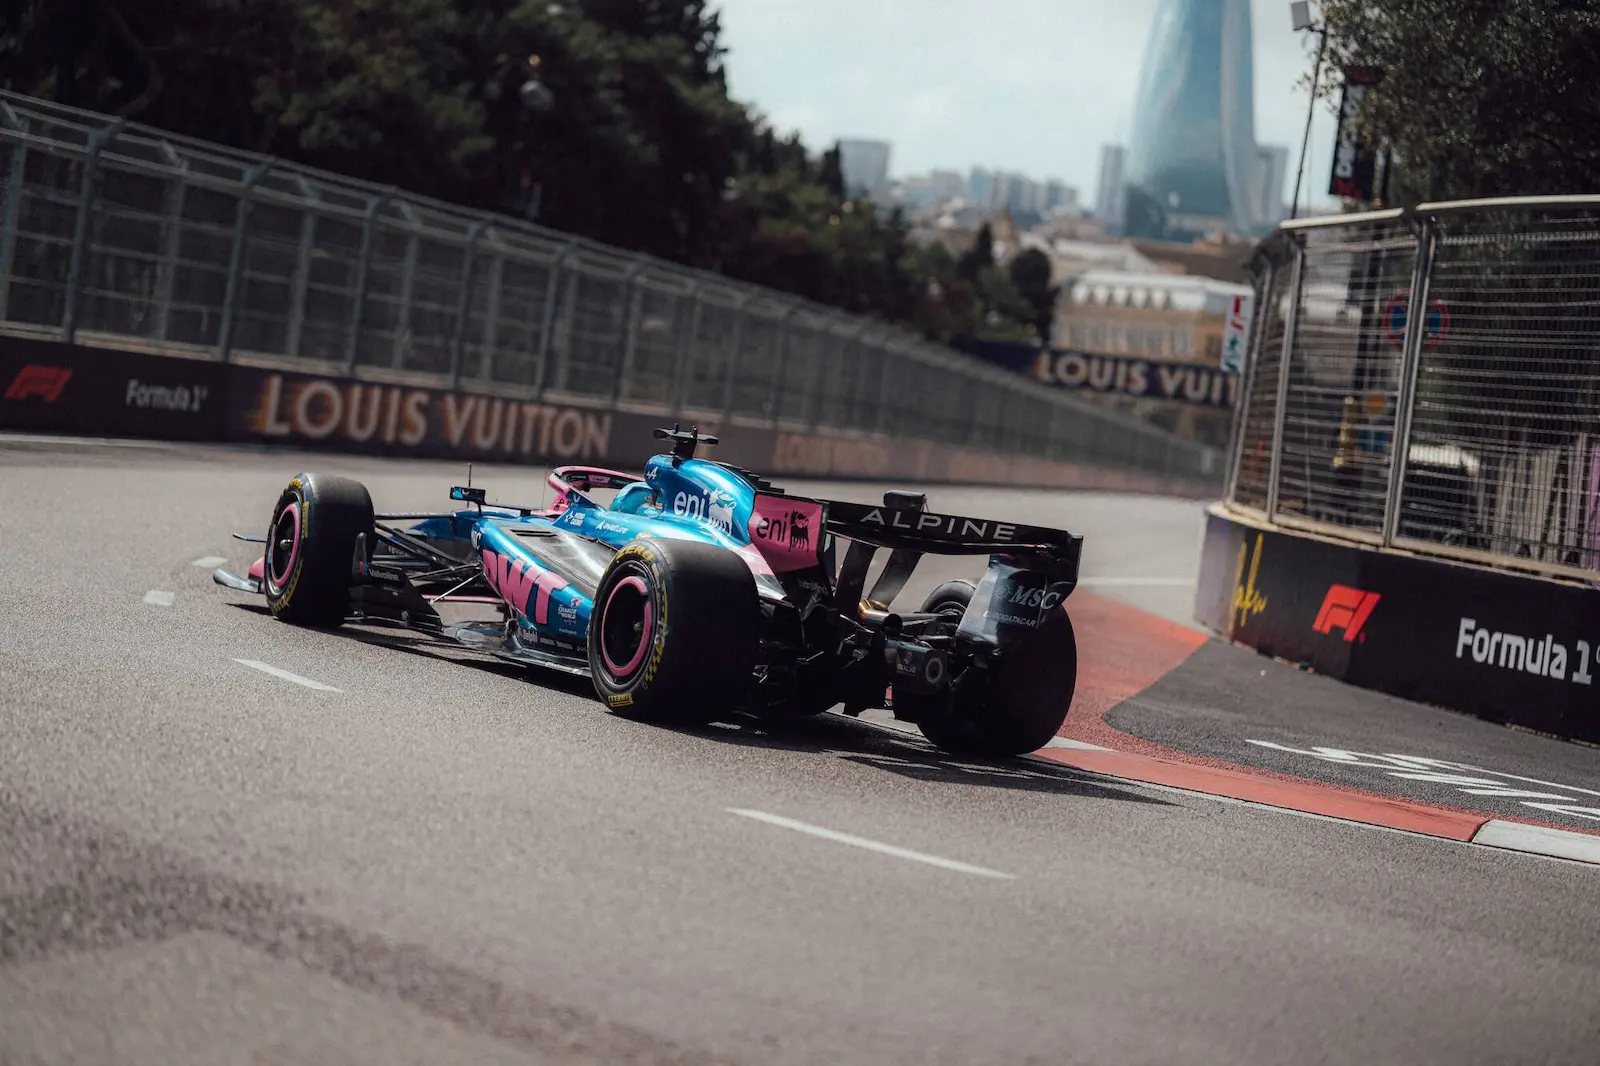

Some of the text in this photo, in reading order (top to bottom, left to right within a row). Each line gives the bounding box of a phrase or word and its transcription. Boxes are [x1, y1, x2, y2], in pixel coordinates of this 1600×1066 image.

[1037, 350, 1150, 396] LOUIS
[126, 378, 189, 411] Formula
[263, 375, 612, 458] LOUIS VUITTON
[673, 489, 708, 521] eni
[756, 512, 789, 542] eni
[860, 508, 1017, 541] ALPINE
[1008, 585, 1061, 610] MSC
[1455, 617, 1567, 682] Formula
